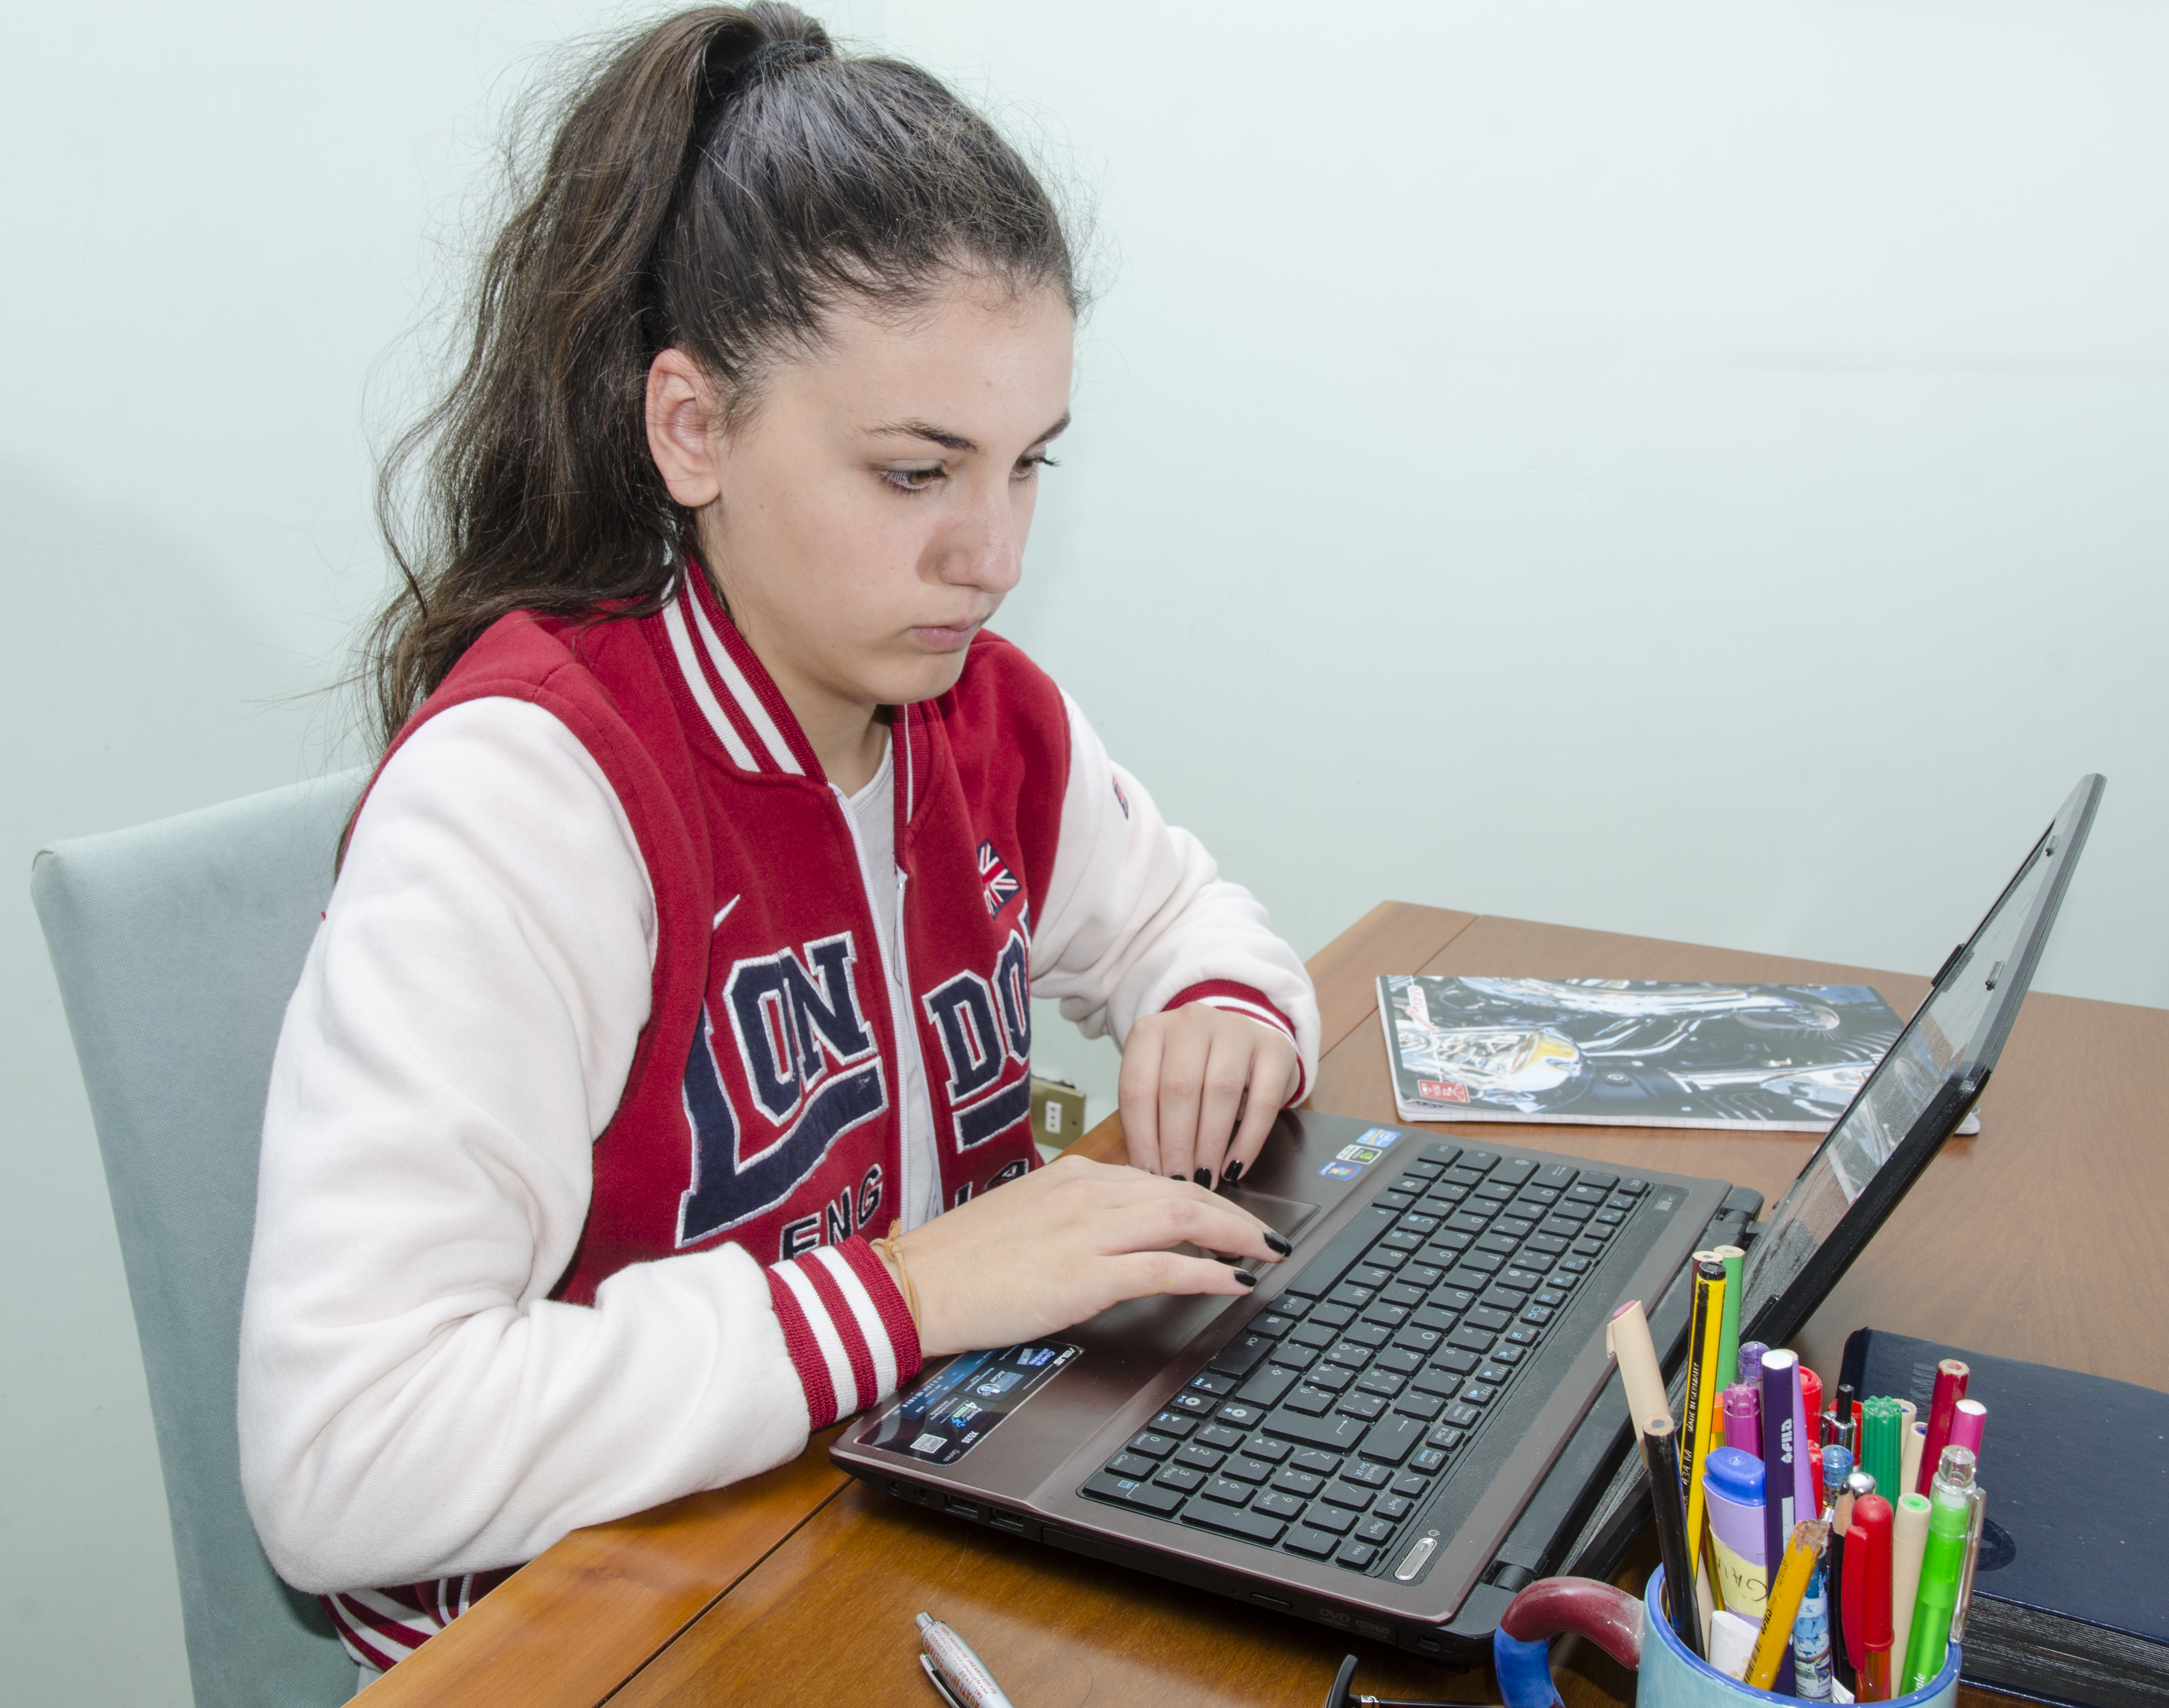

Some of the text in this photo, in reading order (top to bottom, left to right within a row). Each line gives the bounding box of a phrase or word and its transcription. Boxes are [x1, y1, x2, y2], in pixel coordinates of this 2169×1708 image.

[779, 1164, 884, 1262] ENG
[1353, 1288, 1367, 1297] M
[1041, 1350, 1056, 1363] Cover
[1053, 1347, 1076, 1366] ASUS
[1510, 1346, 1522, 1355] F10
[990, 1370, 1006, 1383] IceCool
[1496, 1366, 1508, 1375] F11
[1690, 1362, 1700, 1401] GERMANY
[1480, 1386, 1492, 1395] F12
[1453, 1406, 1465, 1417] Interr
[1689, 1400, 1696, 1410] IN
[960, 1408, 975, 1419] Gear
[965, 1407, 983, 1421] Power
[1462, 1408, 1476, 1421] Pausa
[1203, 1425, 1216, 1434] Fine
[961, 1431, 979, 1444] X53S
[1134, 1433, 1149, 1445] Insert
[1444, 1430, 1459, 1443] Stamp
[943, 1449, 960, 1462] Series
[1112, 1454, 1128, 1466] Canc
[1418, 1449, 1432, 1462] Insert
[1428, 1452, 1442, 1464] Canc
[1684, 1449, 1693, 1459] M
[1352, 1545, 1365, 1555] Fine
[1319, 1608, 1351, 1622] DVD
[1357, 1620, 1389, 1635] MULTI
[960, 1683, 980, 1708] AGATI
